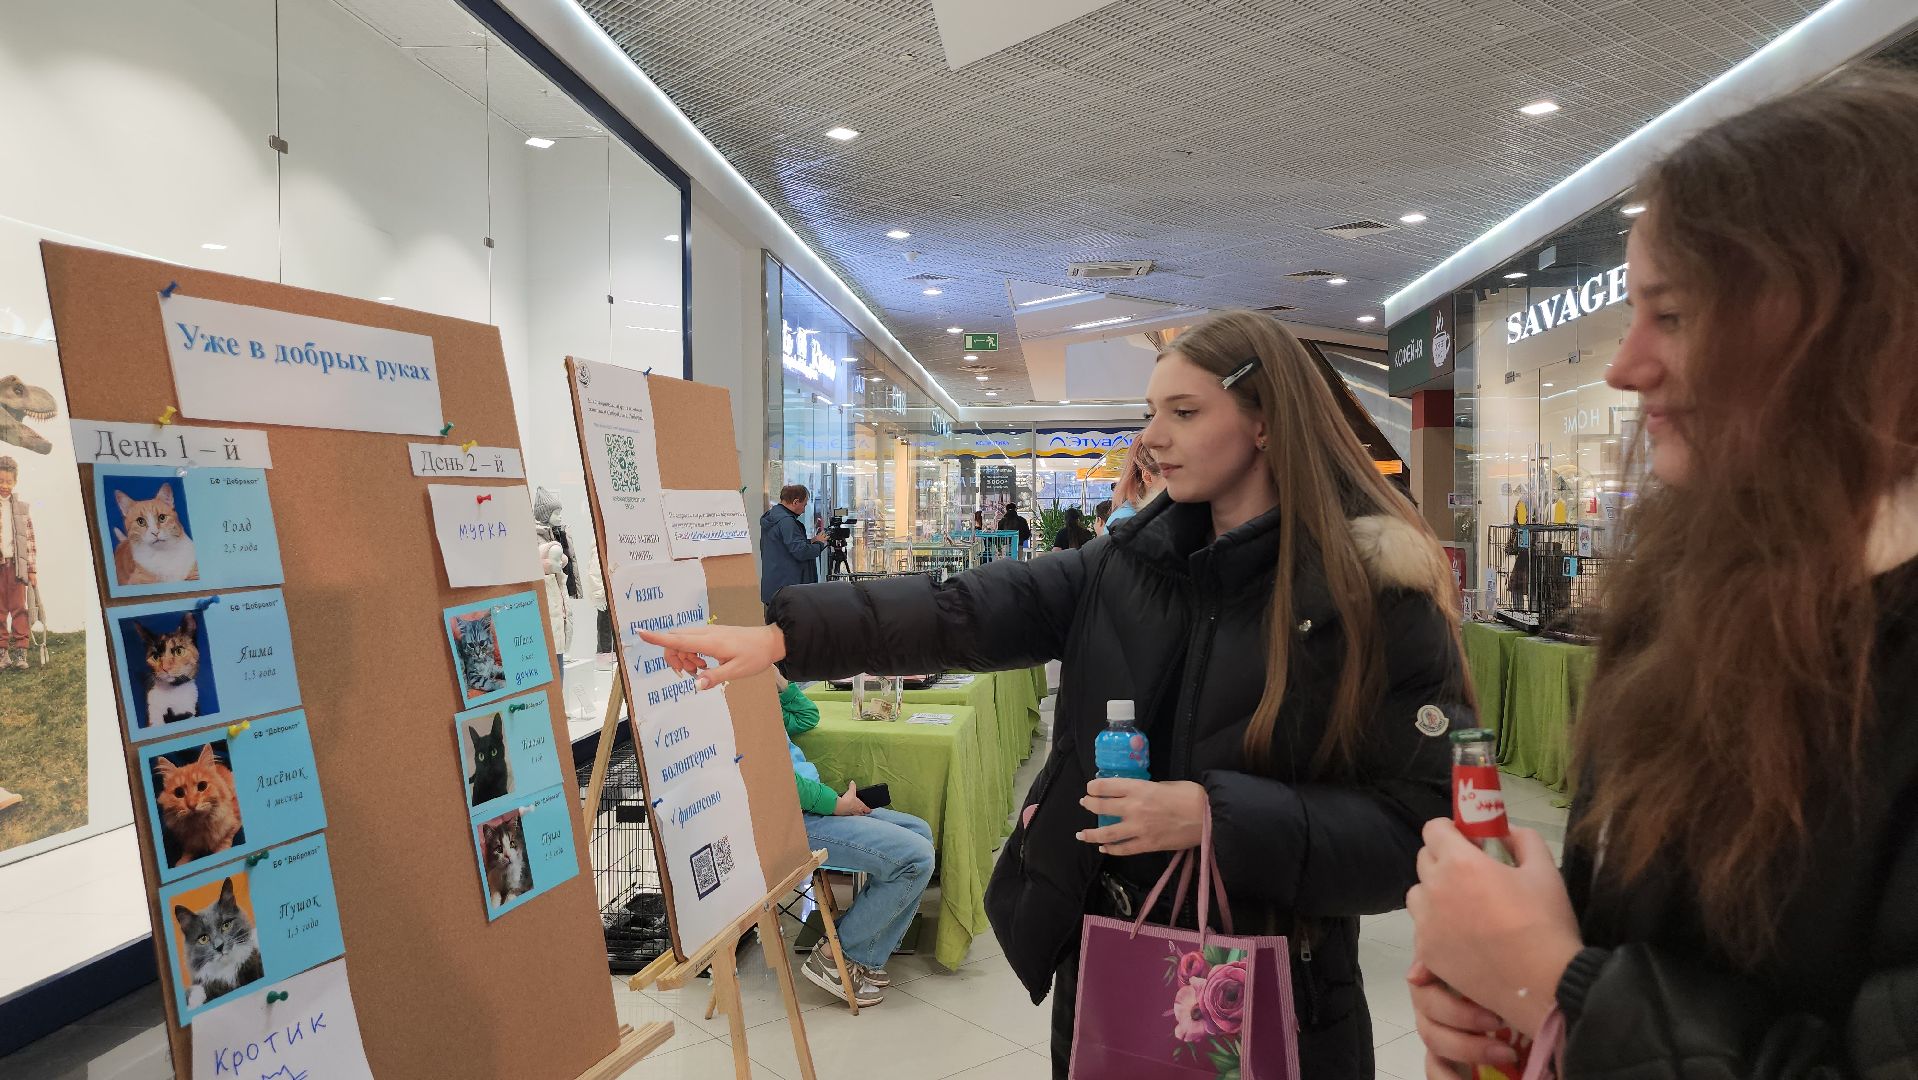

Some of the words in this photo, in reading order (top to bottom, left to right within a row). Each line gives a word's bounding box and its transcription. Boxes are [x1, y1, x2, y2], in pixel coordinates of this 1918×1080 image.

[1507, 262, 1629, 344] SAVAGE
[177, 321, 241, 356] Уже
[249, 340, 266, 359] в
[274, 341, 370, 374] добрых
[375, 358, 431, 383] руках
[1394, 338, 1423, 368] КОФЕЙНЯ
[94, 430, 168, 462] День
[176, 434, 189, 459] 1
[223, 437, 241, 461] й
[421, 450, 464, 475] День
[466, 453, 478, 472] 2
[494, 454, 505, 473] й
[222, 517, 252, 533] Голд
[459, 521, 508, 540] МУРКА
[635, 586, 664, 603] взять
[676, 603, 704, 628] домой
[235, 645, 273, 664] Яшма
[644, 656, 670, 675] взят
[647, 689, 661, 706] на
[661, 743, 718, 783] волонтером
[256, 767, 309, 793] Лисёнок
[279, 895, 321, 921] Пушок
